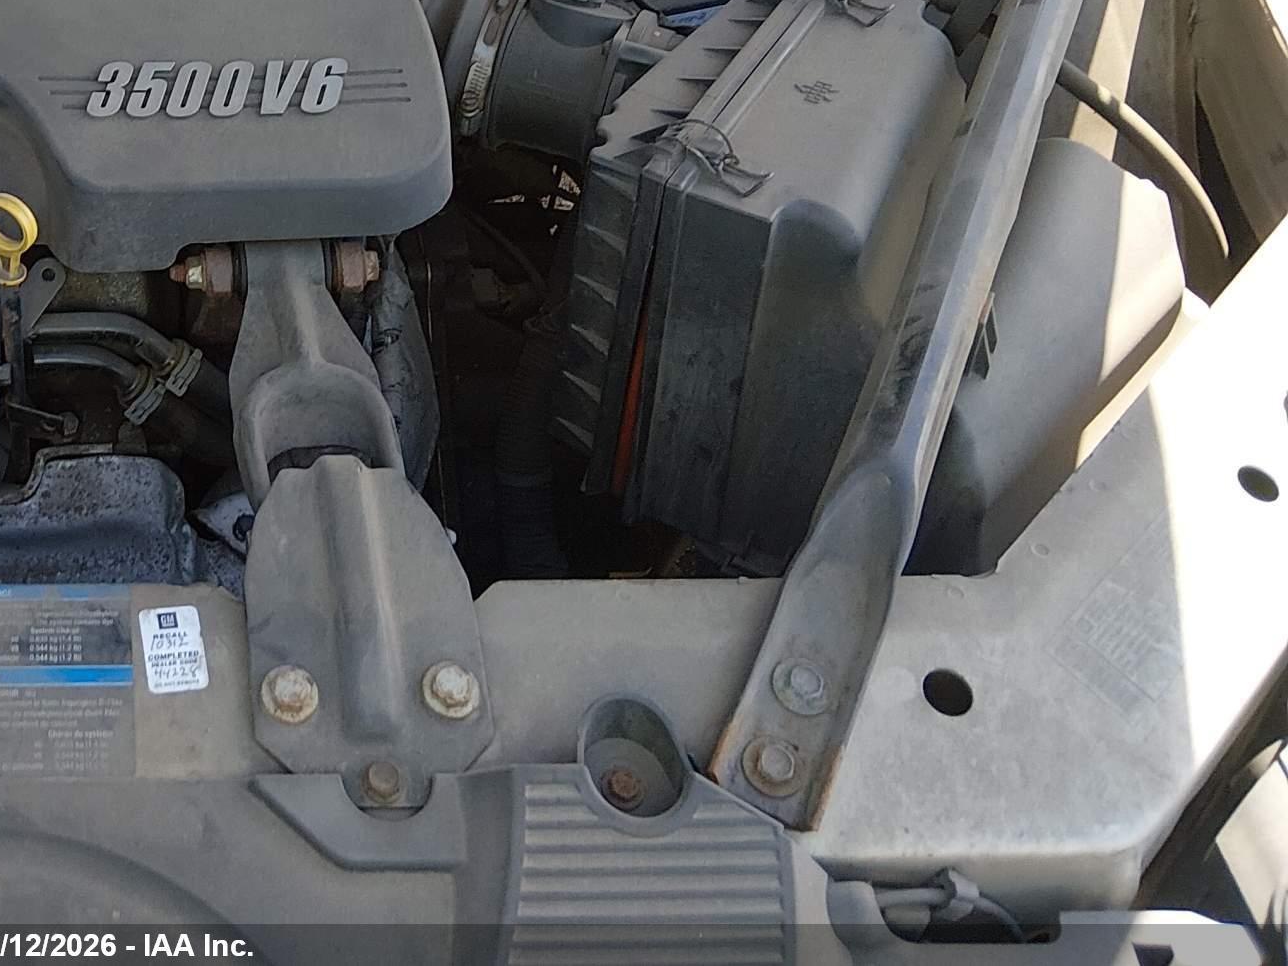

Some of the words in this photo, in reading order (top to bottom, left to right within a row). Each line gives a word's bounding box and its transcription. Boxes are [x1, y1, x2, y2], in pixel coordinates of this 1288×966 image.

[86, 59, 255, 118] 3500
[259, 57, 349, 115] V6
[160, 614, 176, 627] GM
[152, 630, 187, 640] RECALL
[147, 650, 200, 662] COMPLETED
